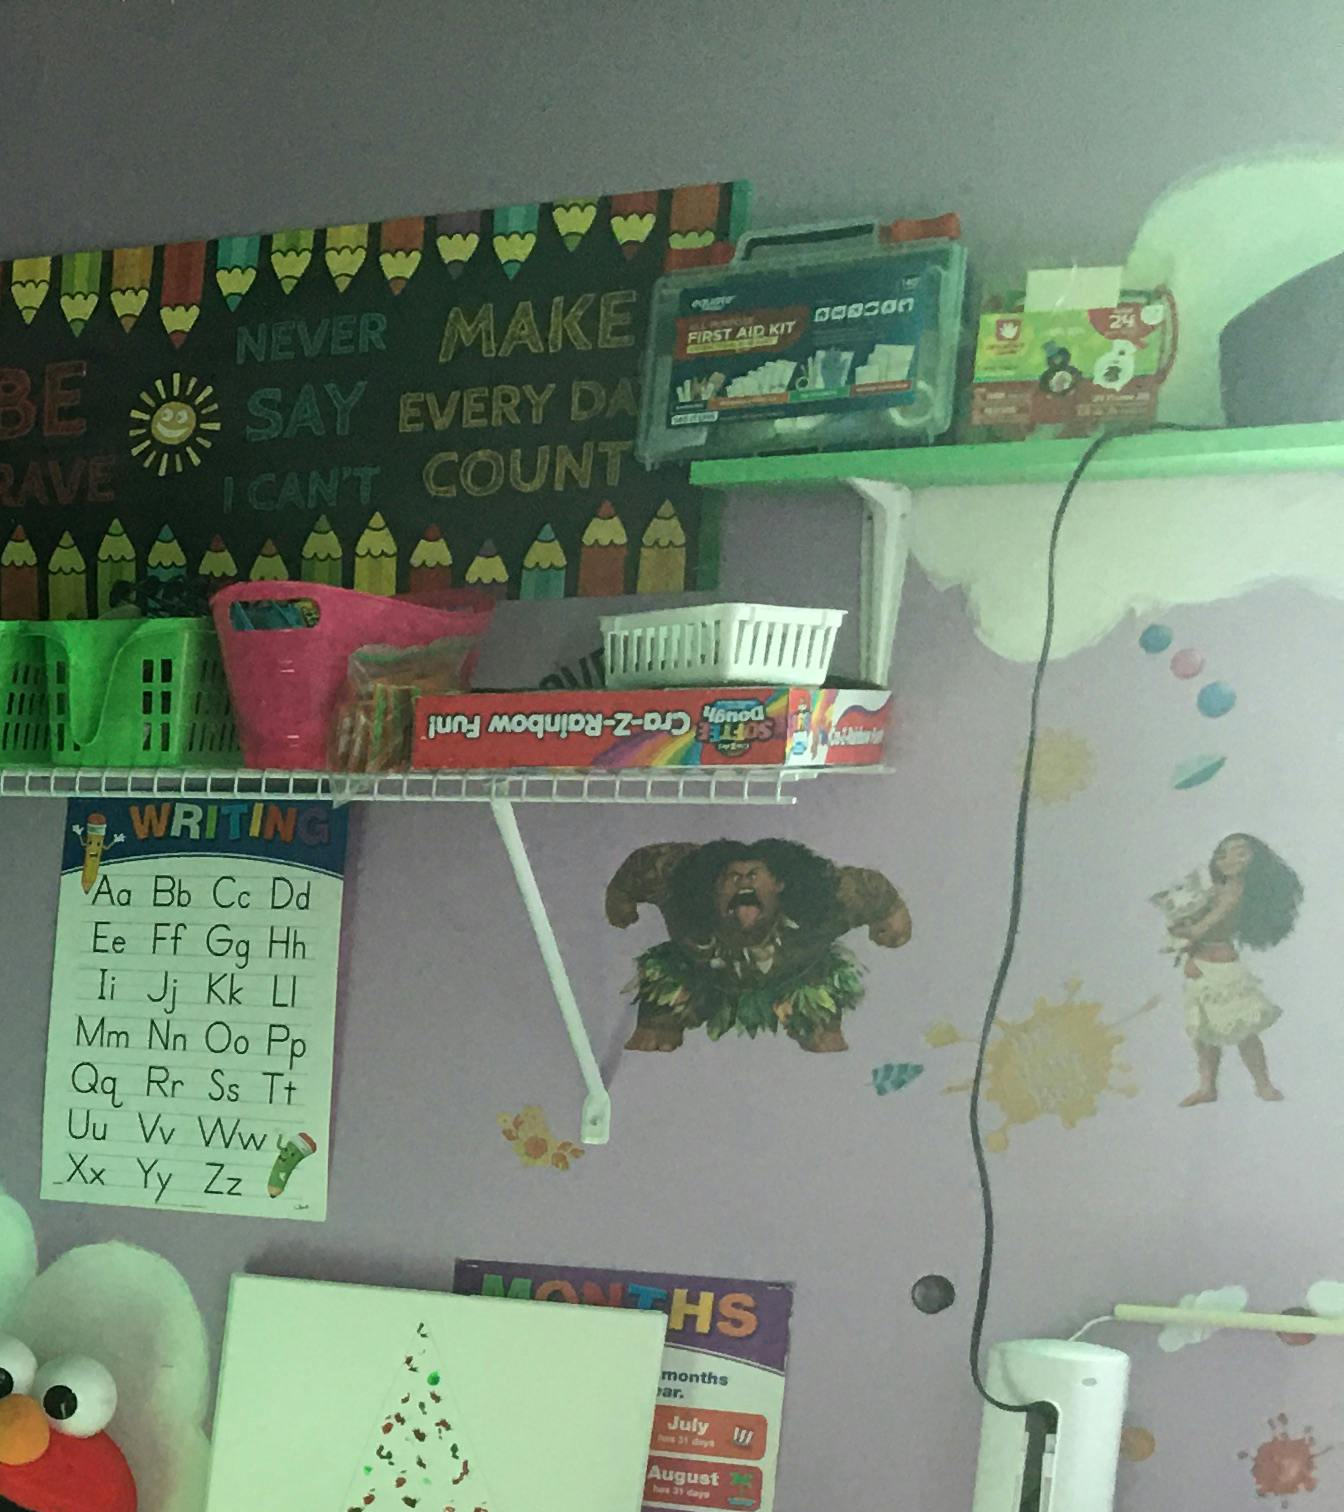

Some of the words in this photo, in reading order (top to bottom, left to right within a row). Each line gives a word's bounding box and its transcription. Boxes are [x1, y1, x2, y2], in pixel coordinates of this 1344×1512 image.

[235, 312, 388, 365] NEVER
[438, 290, 638, 364] MAKE
[688, 329, 732, 344] FIRST
[737, 326, 765, 340] AID
[769, 321, 796, 335] KIT
[246, 380, 368, 442] SAY
[398, 383, 556, 433] EVERY
[247, 465, 381, 511] CAN'T
[423, 441, 634, 498] COUNT
[427, 715, 481, 739] Fun!
[488, 709, 691, 738] Cra-Z-Rainbow
[703, 705, 764, 723] Dough
[129, 802, 330, 845] WRITING
[92, 875, 131, 906] Aa
[153, 875, 192, 907] Bb
[213, 876, 250, 909] Cc
[271, 877, 311, 910] Dd
[93, 922, 126, 953] Ee
[152, 922, 187, 955] Ff
[206, 924, 250, 969] Gg
[269, 926, 306, 959] Hh
[98, 969, 116, 1000] Ii
[147, 971, 178, 1014] Jj
[207, 973, 243, 1005] Kk
[272, 975, 296, 1008] Ll
[76, 1015, 129, 1048] Mm
[148, 1018, 187, 1051] Nn
[206, 1021, 249, 1055] Oo
[267, 1024, 306, 1070] Pp
[72, 1062, 123, 1108] Qq
[147, 1066, 184, 1098] Rr
[209, 1069, 240, 1102] Ss
[263, 1071, 297, 1105] Tt
[68, 1108, 107, 1140] Uu
[138, 1113, 175, 1145] Vv
[198, 1116, 267, 1150] Ww
[67, 1153, 105, 1185] Xx
[137, 1157, 172, 1203] Yy
[204, 1162, 242, 1196] Zz
[661, 1371, 728, 1386] months
[668, 1416, 709, 1435] July
[647, 1465, 720, 1486] August
